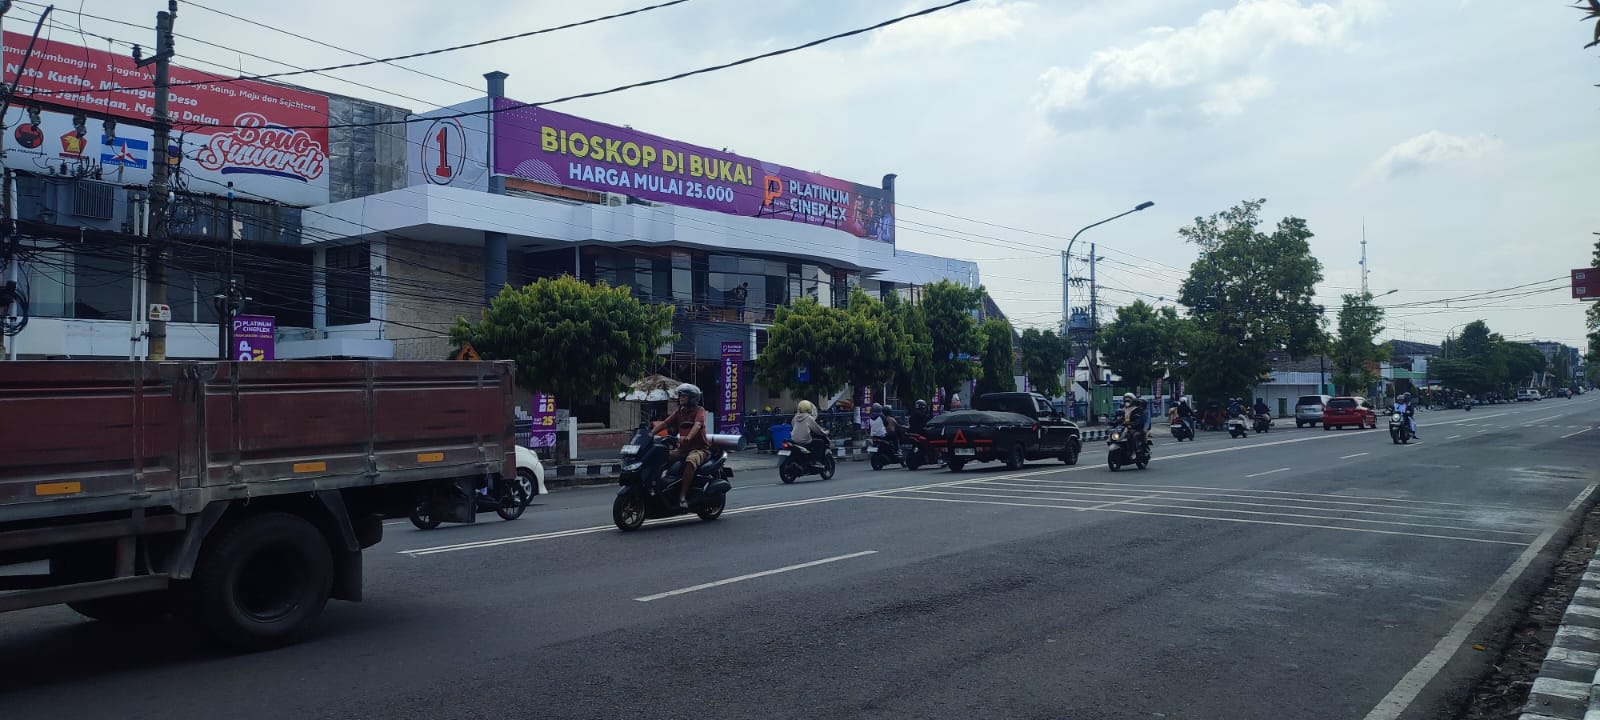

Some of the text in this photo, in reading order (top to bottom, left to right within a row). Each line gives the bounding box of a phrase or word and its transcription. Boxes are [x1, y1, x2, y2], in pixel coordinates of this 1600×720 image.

[6, 63, 198, 106] Noto Kutho, Mbangu Deso
[31, 50, 97, 69] Membangun
[107, 64, 141, 79] Sragen
[239, 90, 260, 101] Maju
[262, 94, 277, 104] dan
[56, 89, 130, 111] Jembatan,
[183, 111, 220, 126] Dalan
[235, 113, 320, 155] Bowo
[436, 126, 451, 177] 1
[198, 133, 323, 179] Suwardi
[541, 126, 753, 186] BIOSKOP DI BUKA!
[569, 162, 734, 203] HARGA MULAI 25.000
[789, 180, 849, 205] PLATINUM
[790, 198, 847, 221] CINEPLEX
